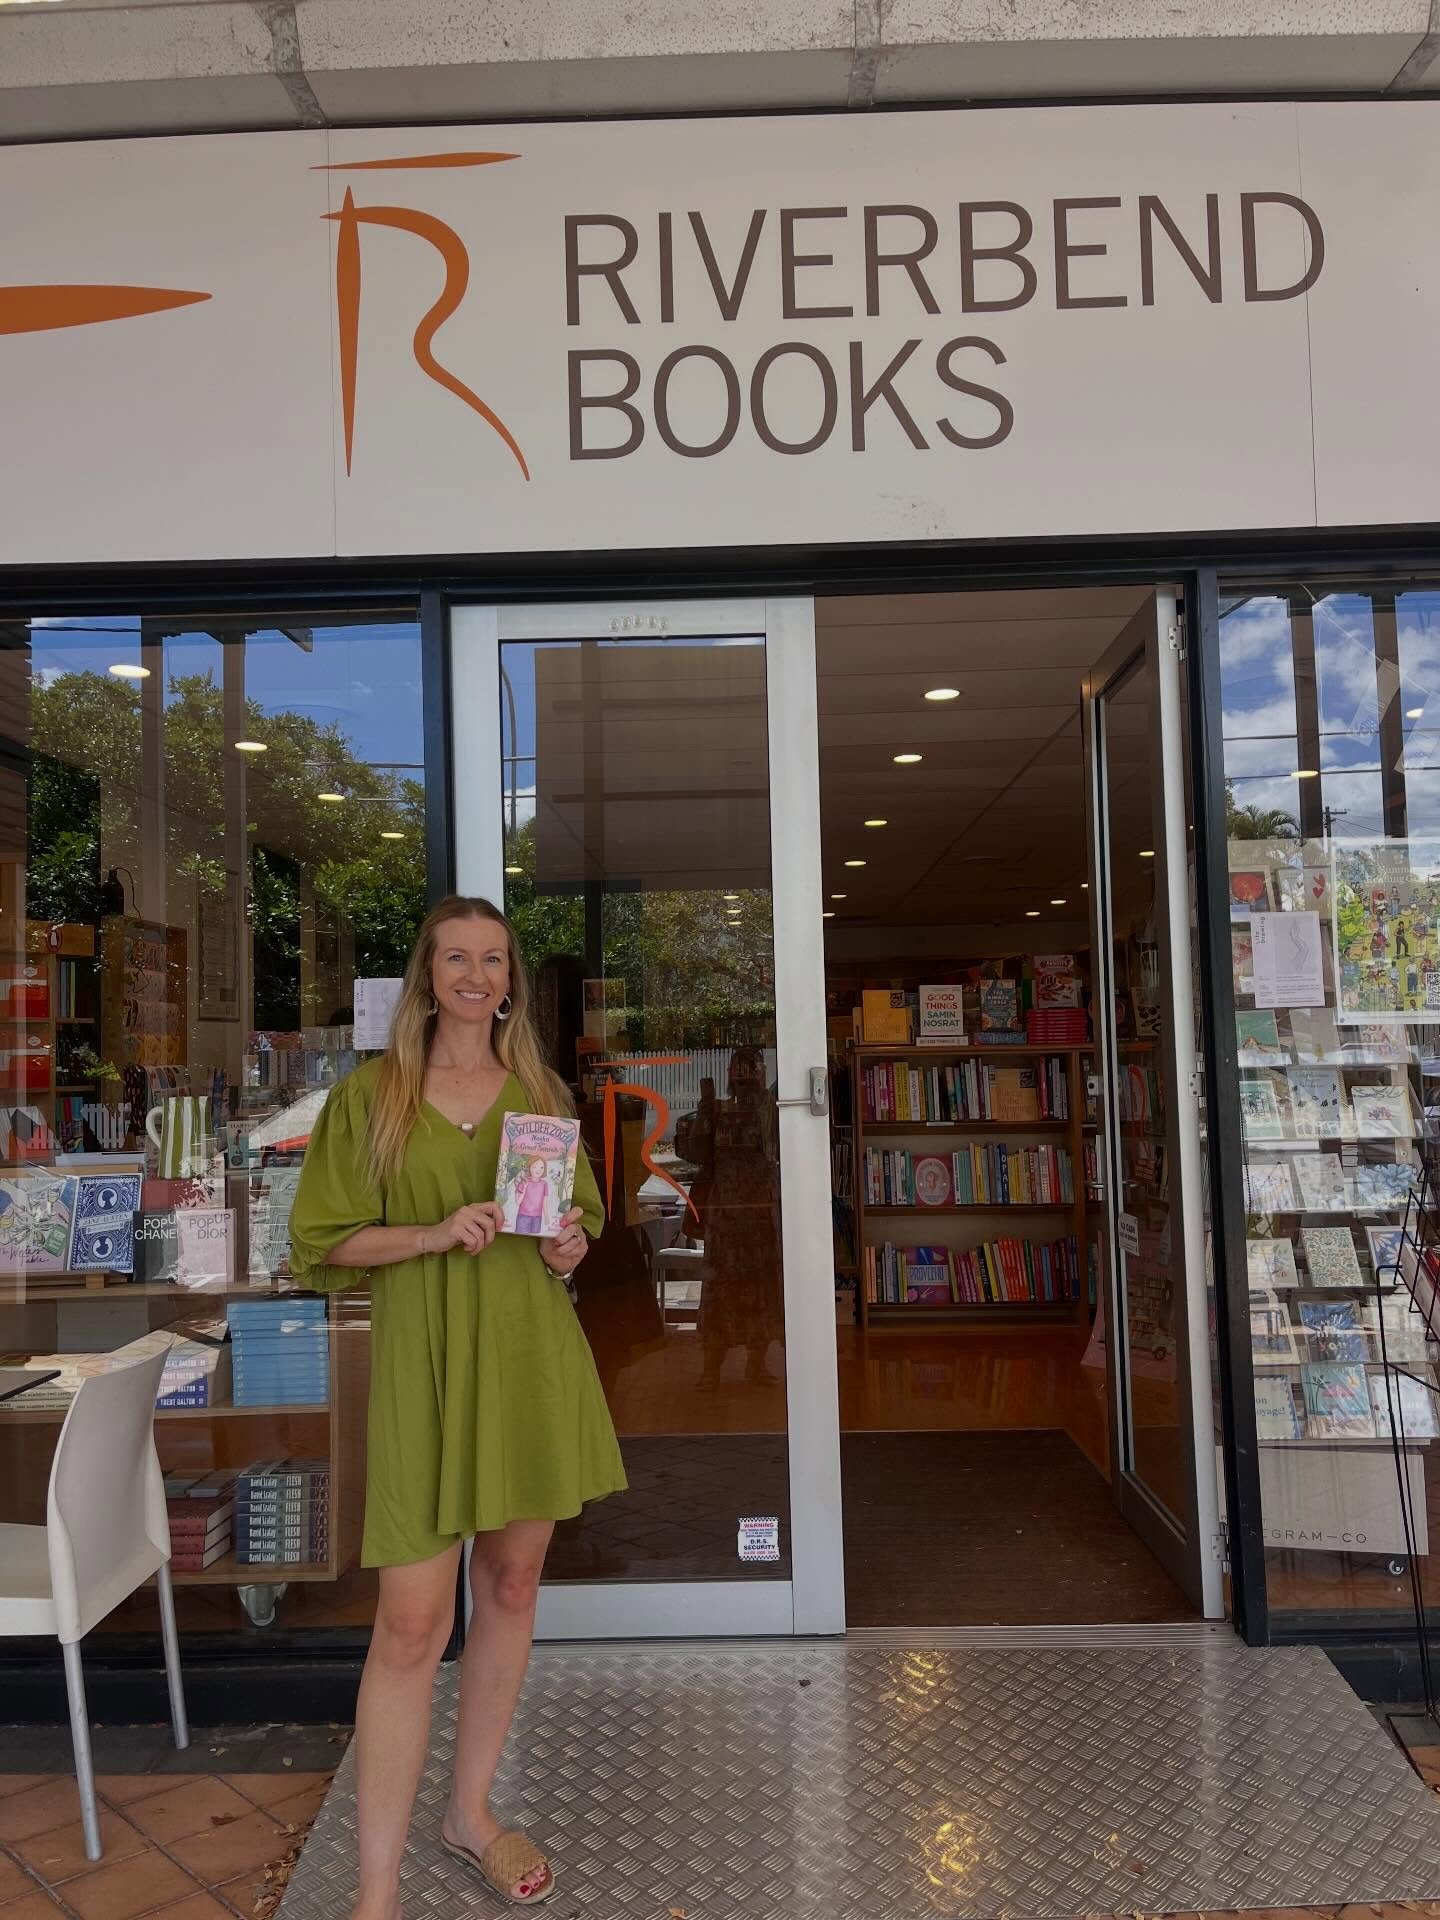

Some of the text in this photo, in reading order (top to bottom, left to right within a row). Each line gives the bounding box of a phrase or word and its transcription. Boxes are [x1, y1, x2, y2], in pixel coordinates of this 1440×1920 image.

[563, 191, 1326, 327] RIVERBEND
[567, 336, 1015, 460] BOOKS
[928, 1011, 956, 1019] SAMIN
[144, 1214, 177, 1229] POPU
[135, 1230, 177, 1240] CHANE
[197, 1229, 228, 1239] DIOR
[1257, 1407, 1286, 1416] oyage!
[286, 1475, 301, 1486] FLESH
[286, 1488, 301, 1498] FLESH
[285, 1502, 300, 1512] FLESH
[285, 1514, 300, 1524] FLESH
[285, 1526, 300, 1536] FLESH
[285, 1538, 300, 1549] FLESH
[284, 1551, 300, 1562] FLESH
